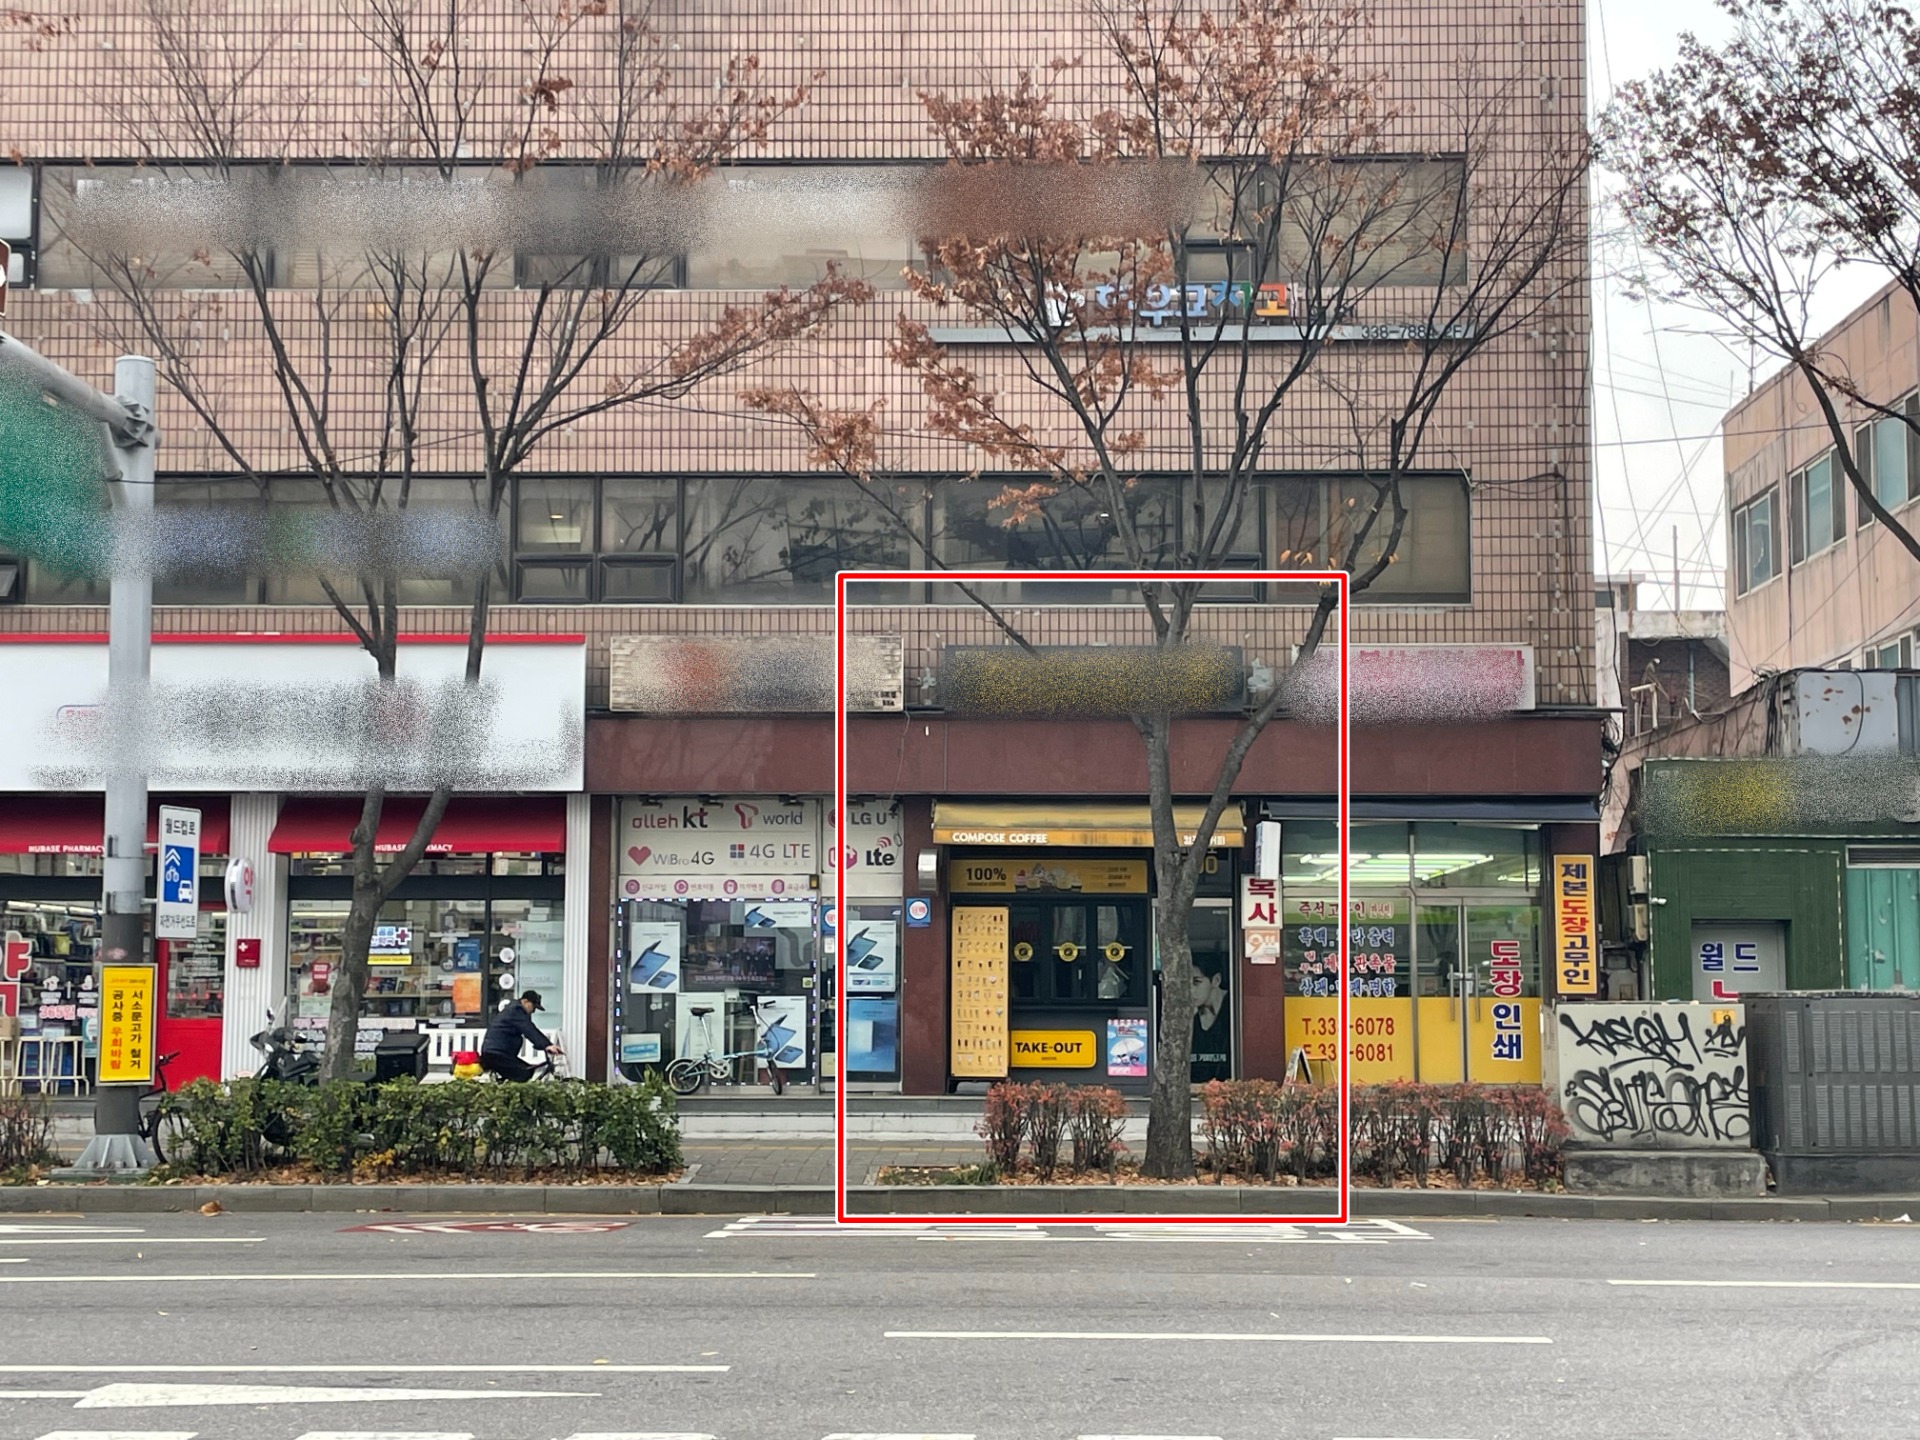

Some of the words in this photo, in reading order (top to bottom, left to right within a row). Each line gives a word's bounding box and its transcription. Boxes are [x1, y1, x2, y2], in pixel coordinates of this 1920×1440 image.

[1361, 324, 1436, 338] 338-788
[632, 814, 678, 829] olleh
[683, 806, 708, 829] kt
[763, 811, 803, 825] world
[851, 812, 872, 825] LG
[952, 832, 1005, 843] COMPOSE
[1009, 833, 1049, 844] COFFEE
[750, 844, 775, 859] 4G
[783, 843, 811, 859] LTE
[966, 867, 1007, 881] 100%
[1490, 941, 1522, 997] 도장
[112, 990, 123, 1022] 공사중
[1302, 1017, 1395, 1036] T.33-6078
[1491, 1003, 1522, 1060] 인쇄
[1015, 1042, 1082, 1054] TAKE-OUT
